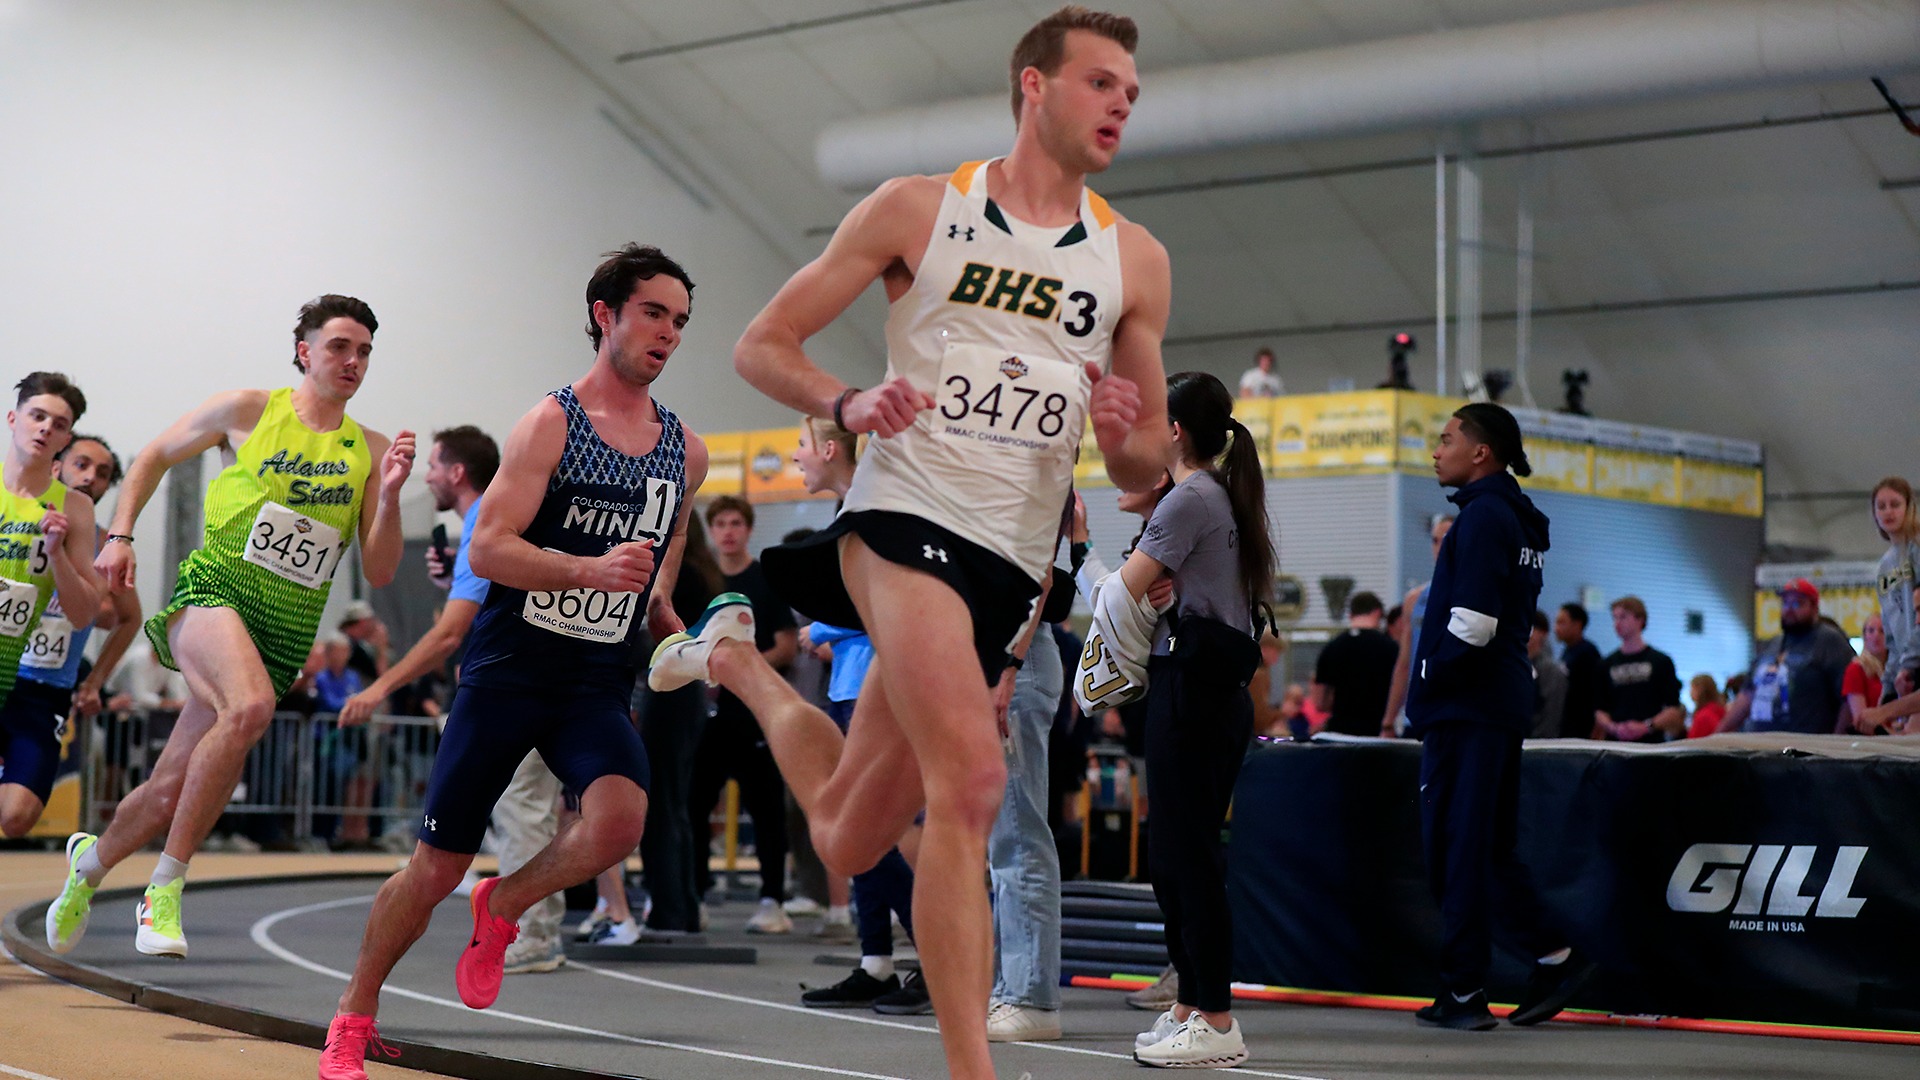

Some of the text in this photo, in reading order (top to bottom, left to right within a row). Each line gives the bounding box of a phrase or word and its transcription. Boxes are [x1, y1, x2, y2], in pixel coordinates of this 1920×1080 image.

[949, 262, 1062, 323] BHS
[1064, 291, 1097, 337] 3
[941, 375, 1067, 437] 3478
[945, 426, 1050, 450] RMAC CHAMPIONSHIP
[258, 448, 350, 478] Adams
[287, 479, 354, 506] State
[655, 483, 668, 530] 1
[33, 540, 48, 574] 5
[252, 521, 329, 574] 3451
[533, 612, 616, 639] RMAC CHAMPIONSHIP
[25, 632, 65, 657] 84
[1666, 843, 1869, 918] GILL
[1729, 919, 1805, 933] MADE IN USA
